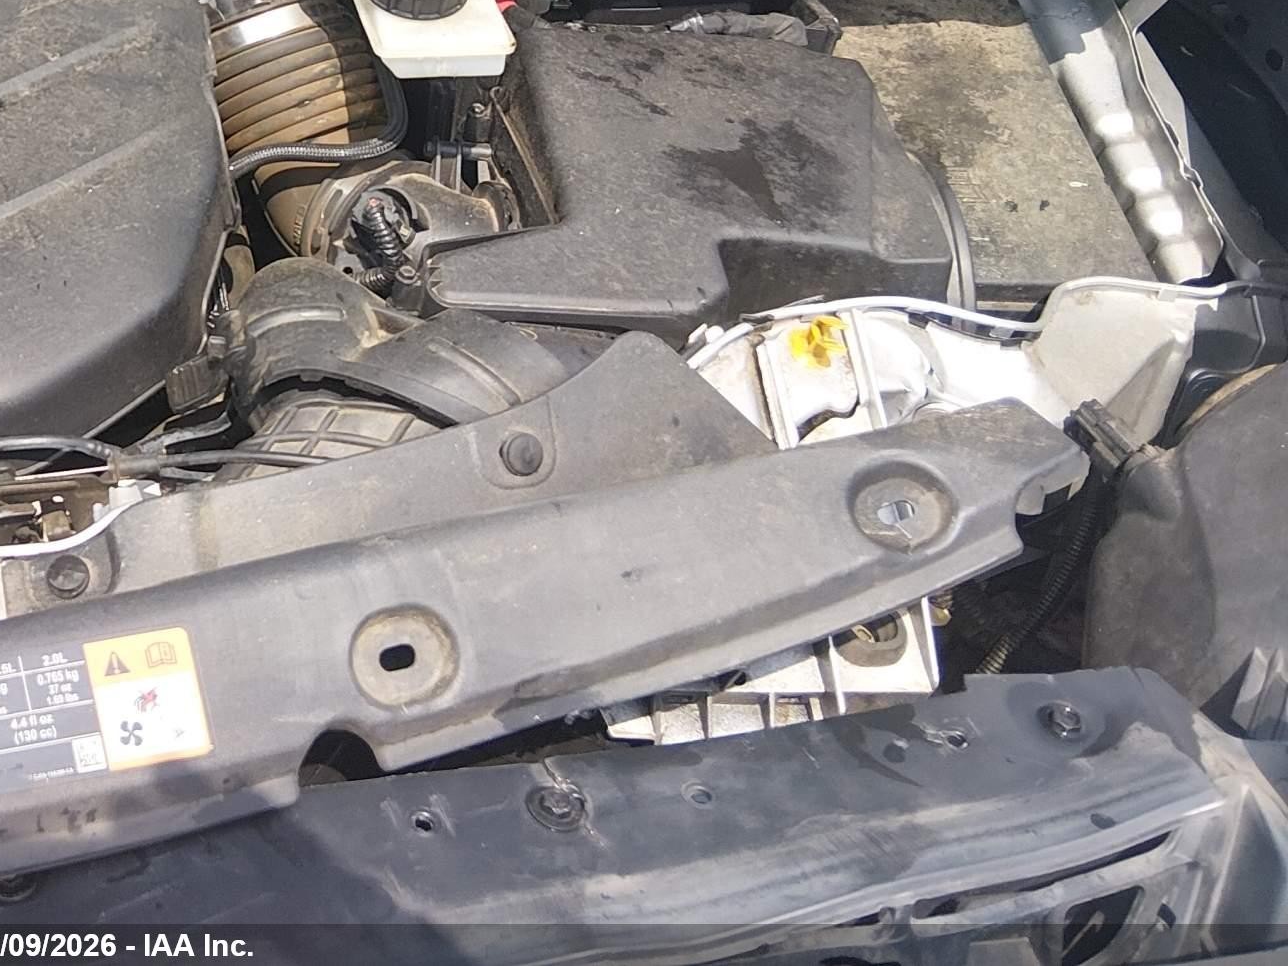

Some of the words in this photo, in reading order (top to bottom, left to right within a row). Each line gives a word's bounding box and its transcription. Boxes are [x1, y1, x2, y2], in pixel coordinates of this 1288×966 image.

[64, 668, 80, 682] kg
[14, 728, 38, 745] (130
[39, 725, 57, 740] cc)
